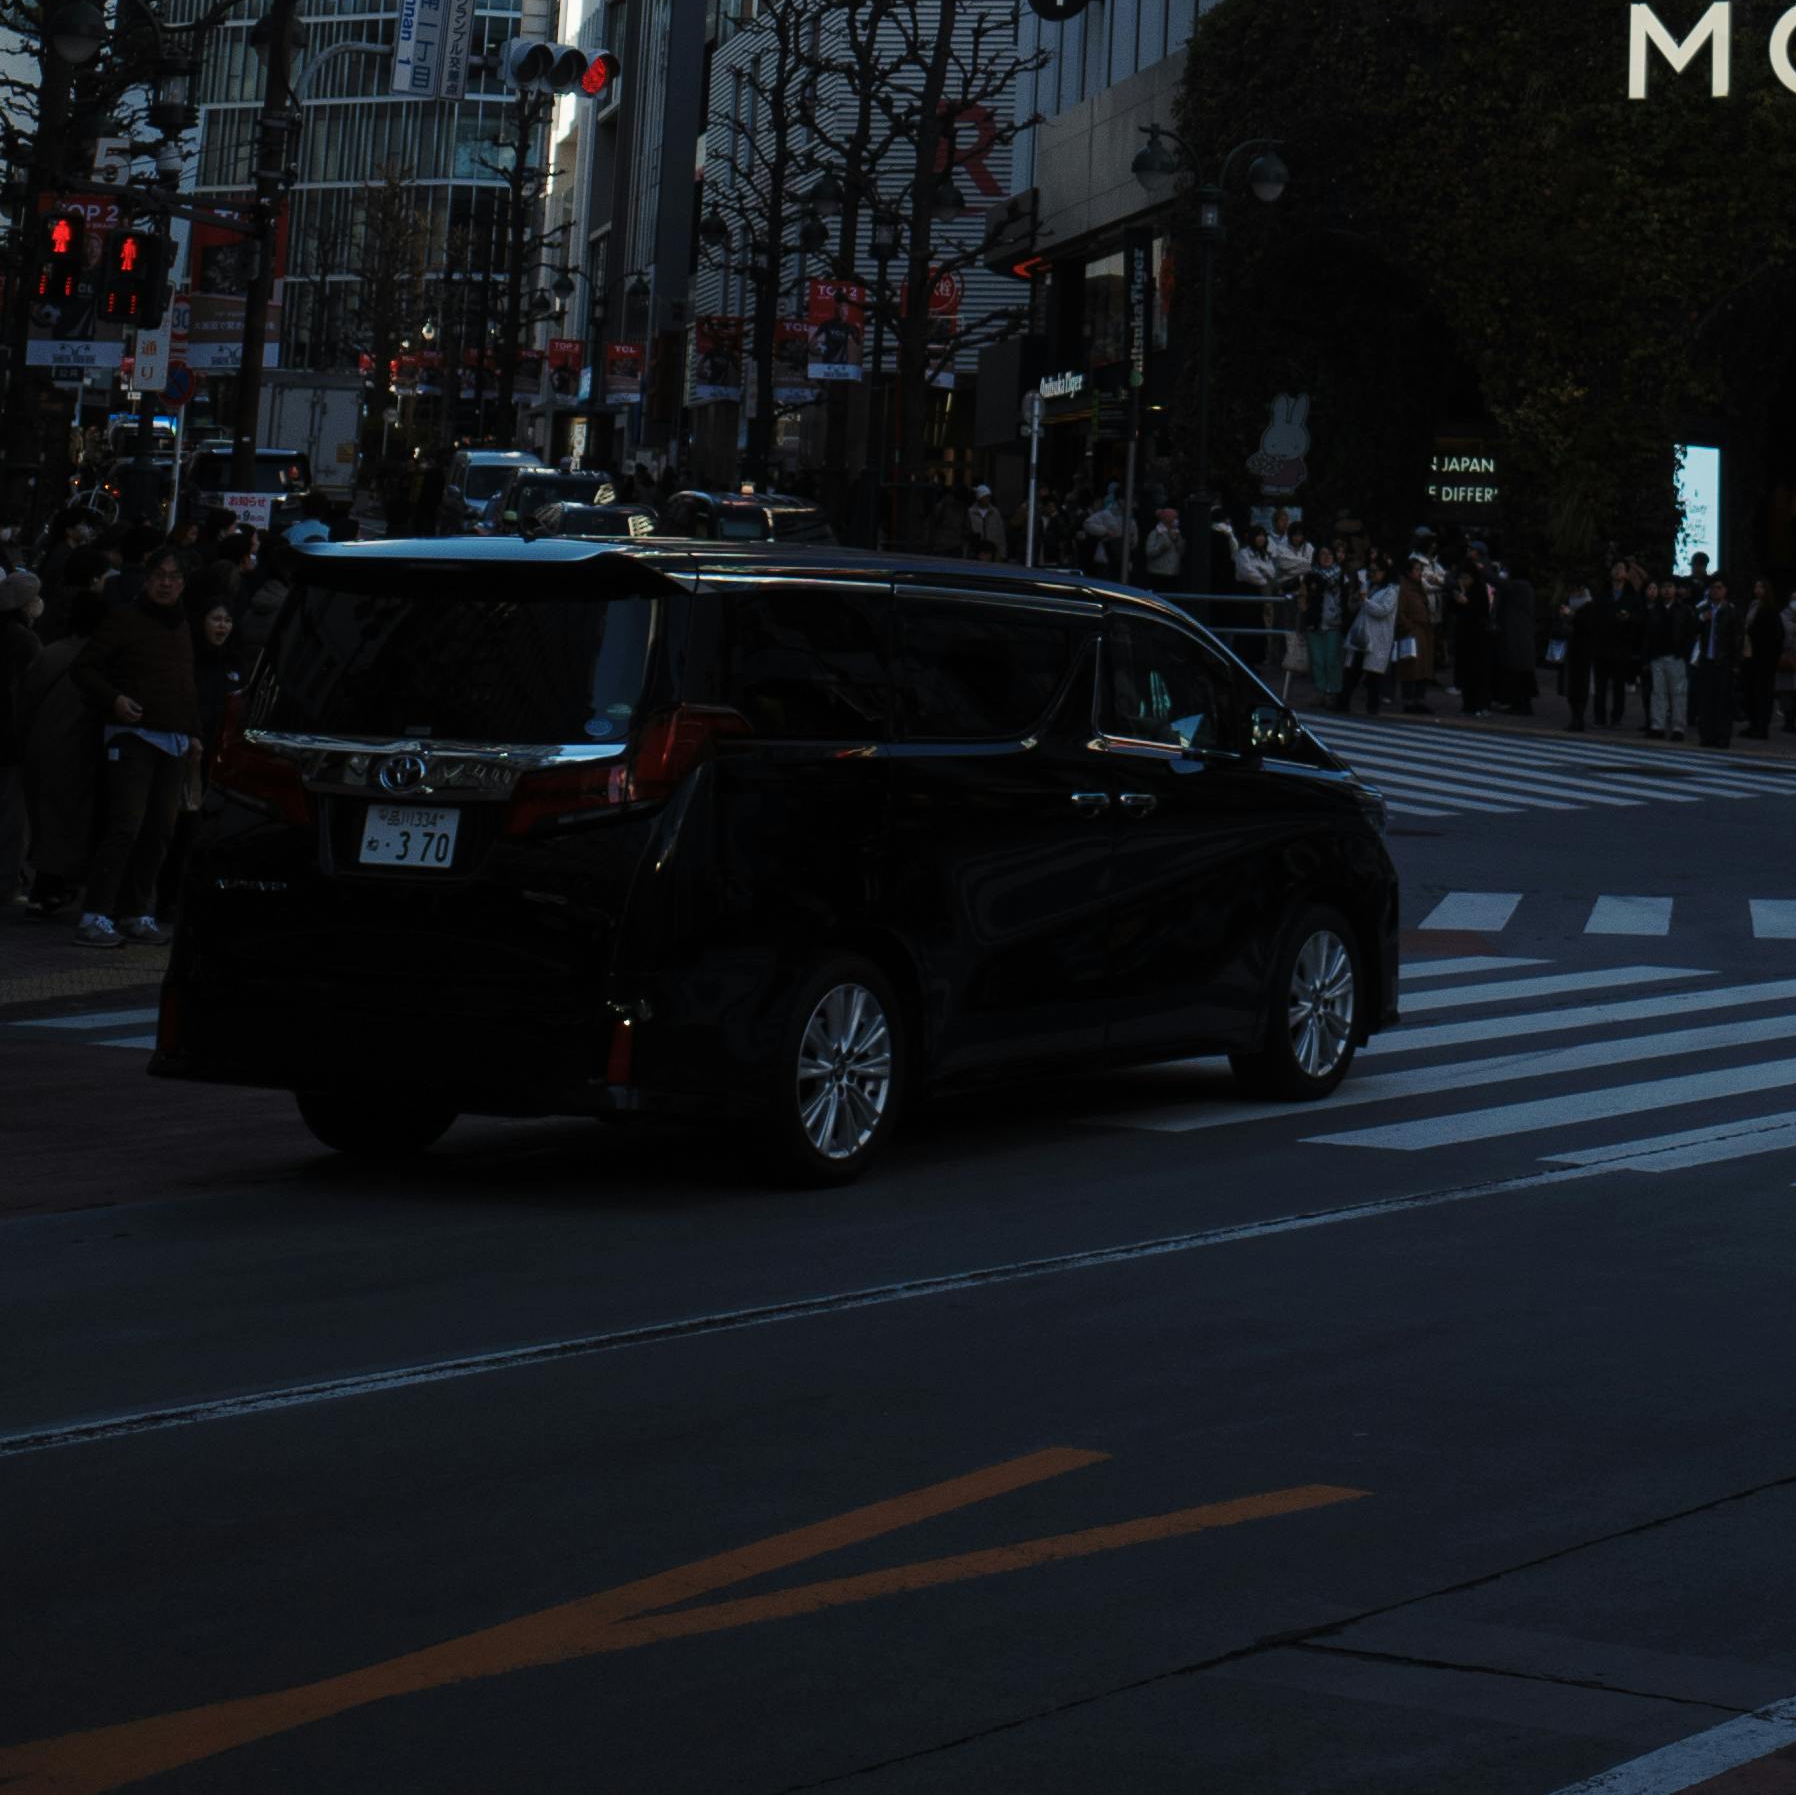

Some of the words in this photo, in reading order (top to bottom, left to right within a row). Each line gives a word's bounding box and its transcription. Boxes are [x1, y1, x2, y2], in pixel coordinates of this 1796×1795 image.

[398, 57, 411, 66] 1
[91, 137, 131, 185] 5
[105, 205, 119, 222] 2
[1441, 457, 1495, 473] JAPAN
[1441, 486, 1499, 503] DIFFER
